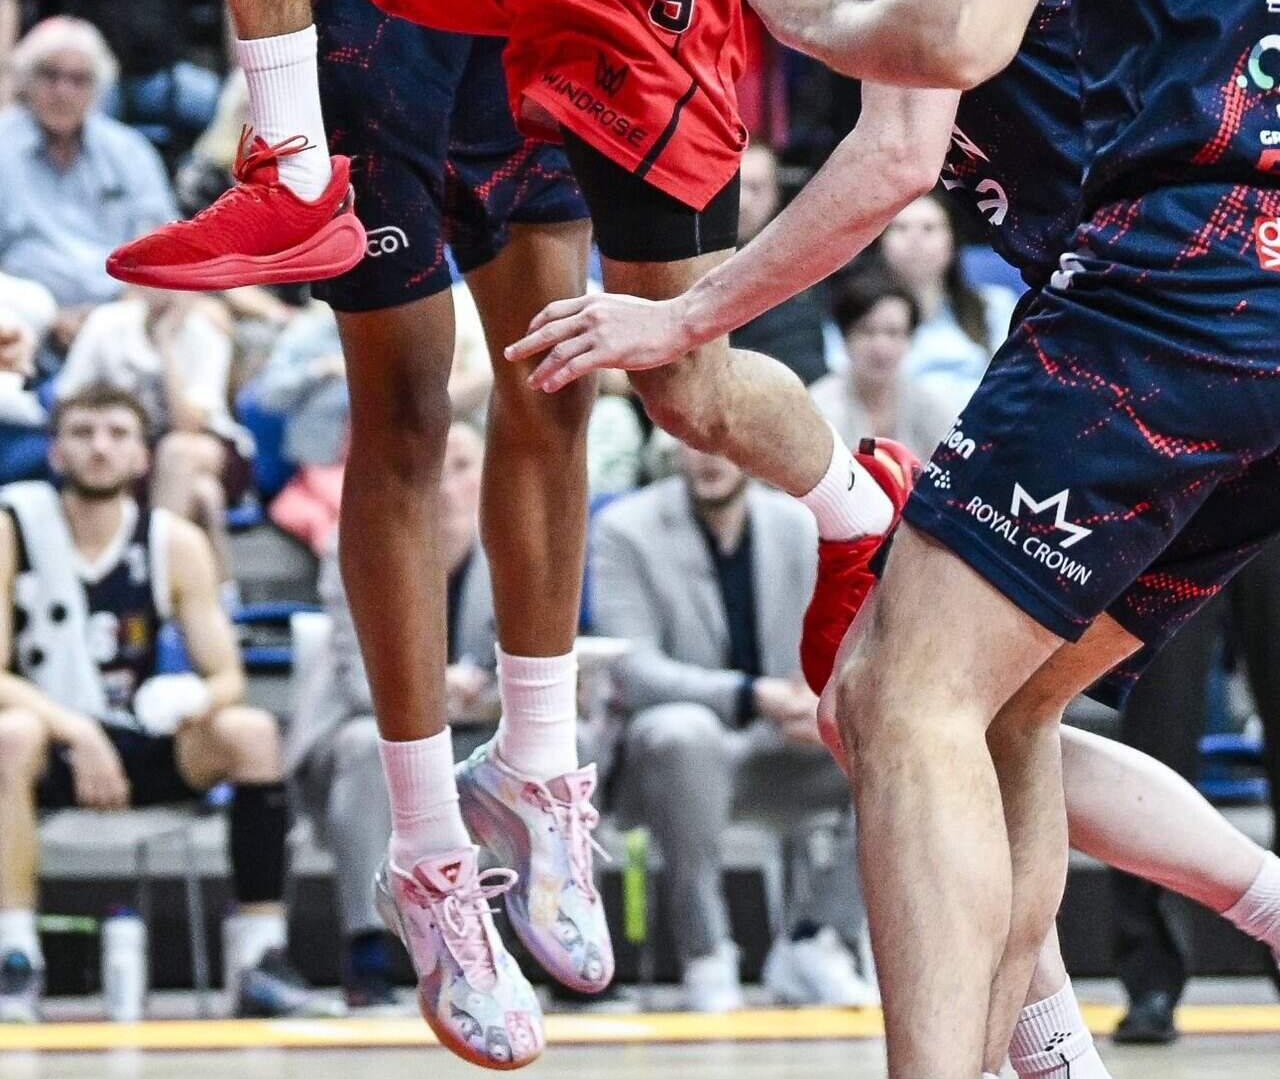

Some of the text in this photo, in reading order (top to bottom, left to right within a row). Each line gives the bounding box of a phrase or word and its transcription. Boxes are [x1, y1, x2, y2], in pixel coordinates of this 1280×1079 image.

[543, 73, 648, 148] WINDROSE
[966, 496, 1092, 586] ROYAL CROWN
